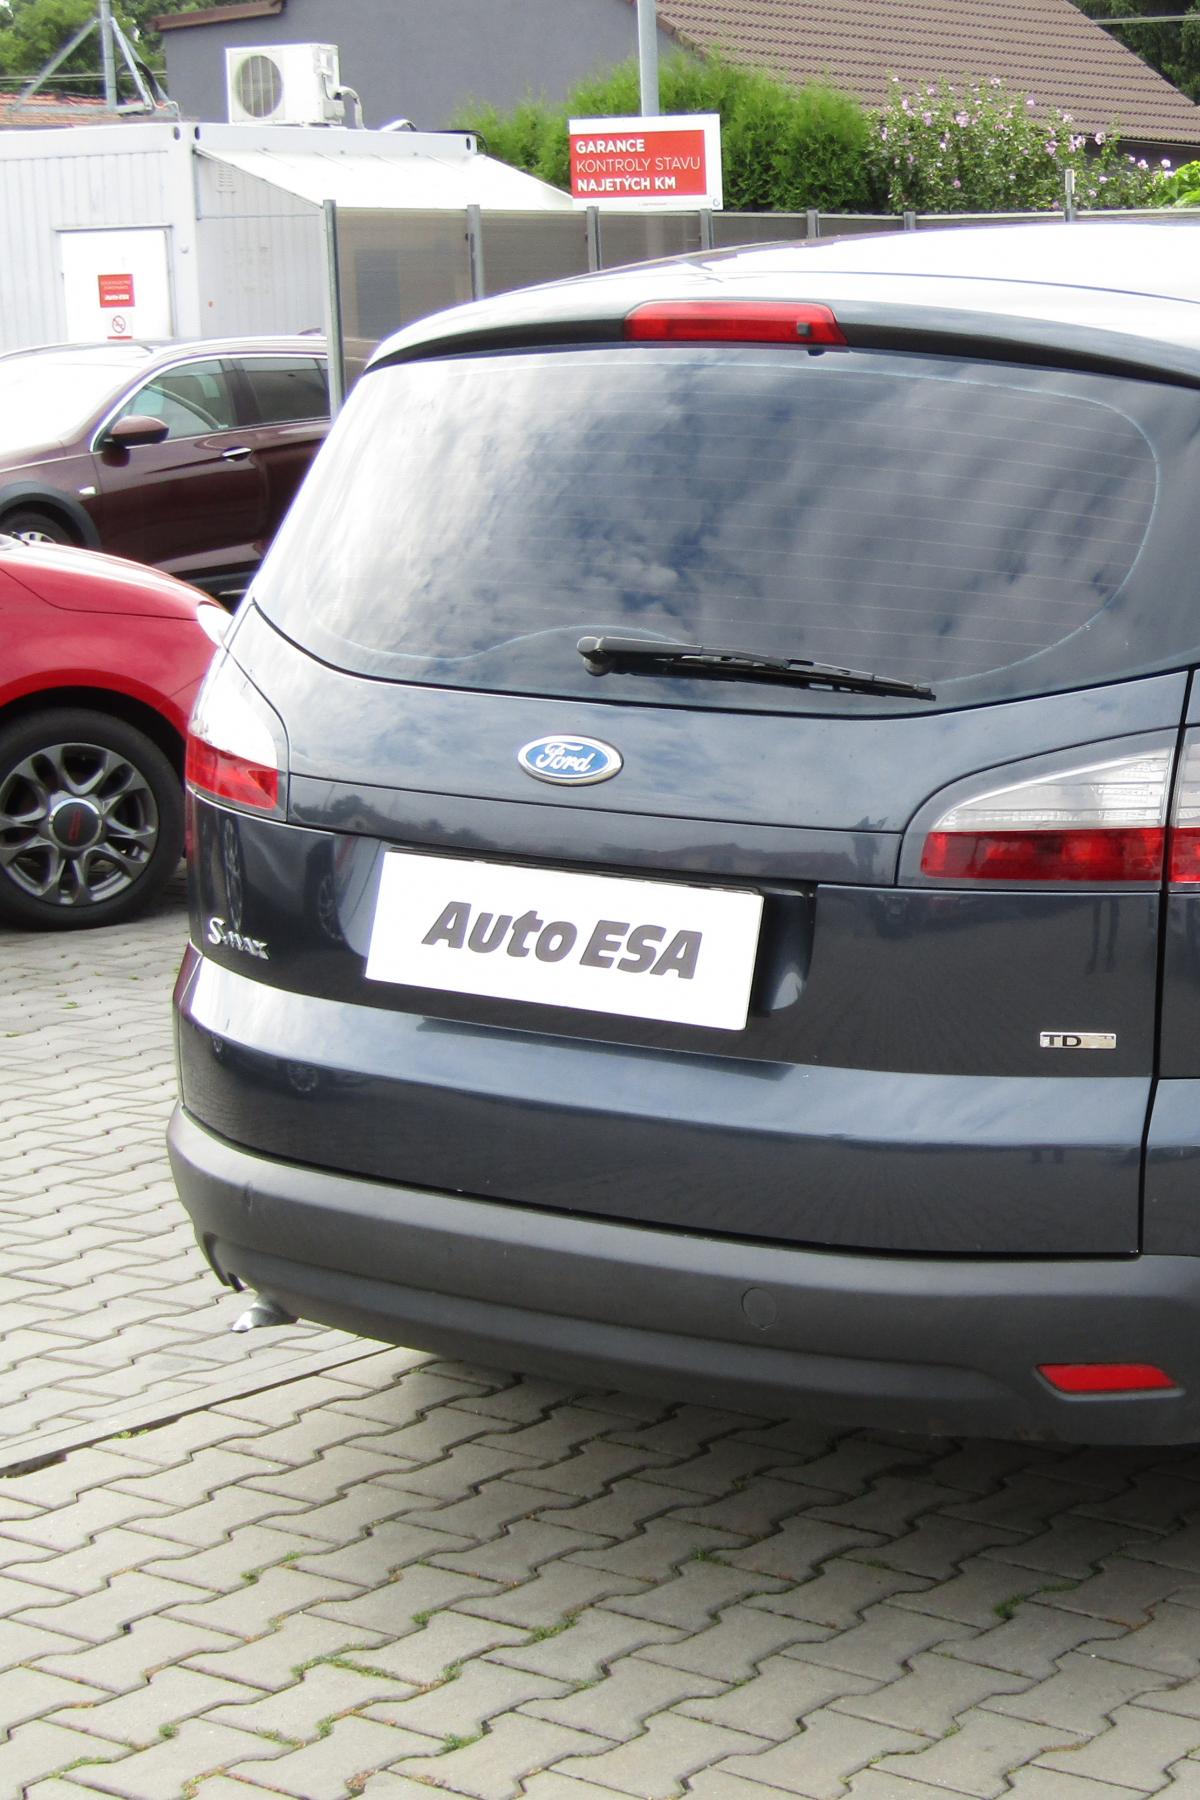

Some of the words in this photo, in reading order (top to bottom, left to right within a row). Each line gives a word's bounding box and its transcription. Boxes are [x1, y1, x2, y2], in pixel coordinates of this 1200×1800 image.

[575, 139, 645, 154] GARANCE
[576, 157, 651, 173] KONTROLY
[655, 156, 701, 171] STAVU
[577, 175, 651, 192] NAJETÝCH
[655, 176, 676, 190] KM
[535, 741, 596, 772] Ford
[420, 900, 578, 963] Auto
[579, 919, 703, 980] ESA
